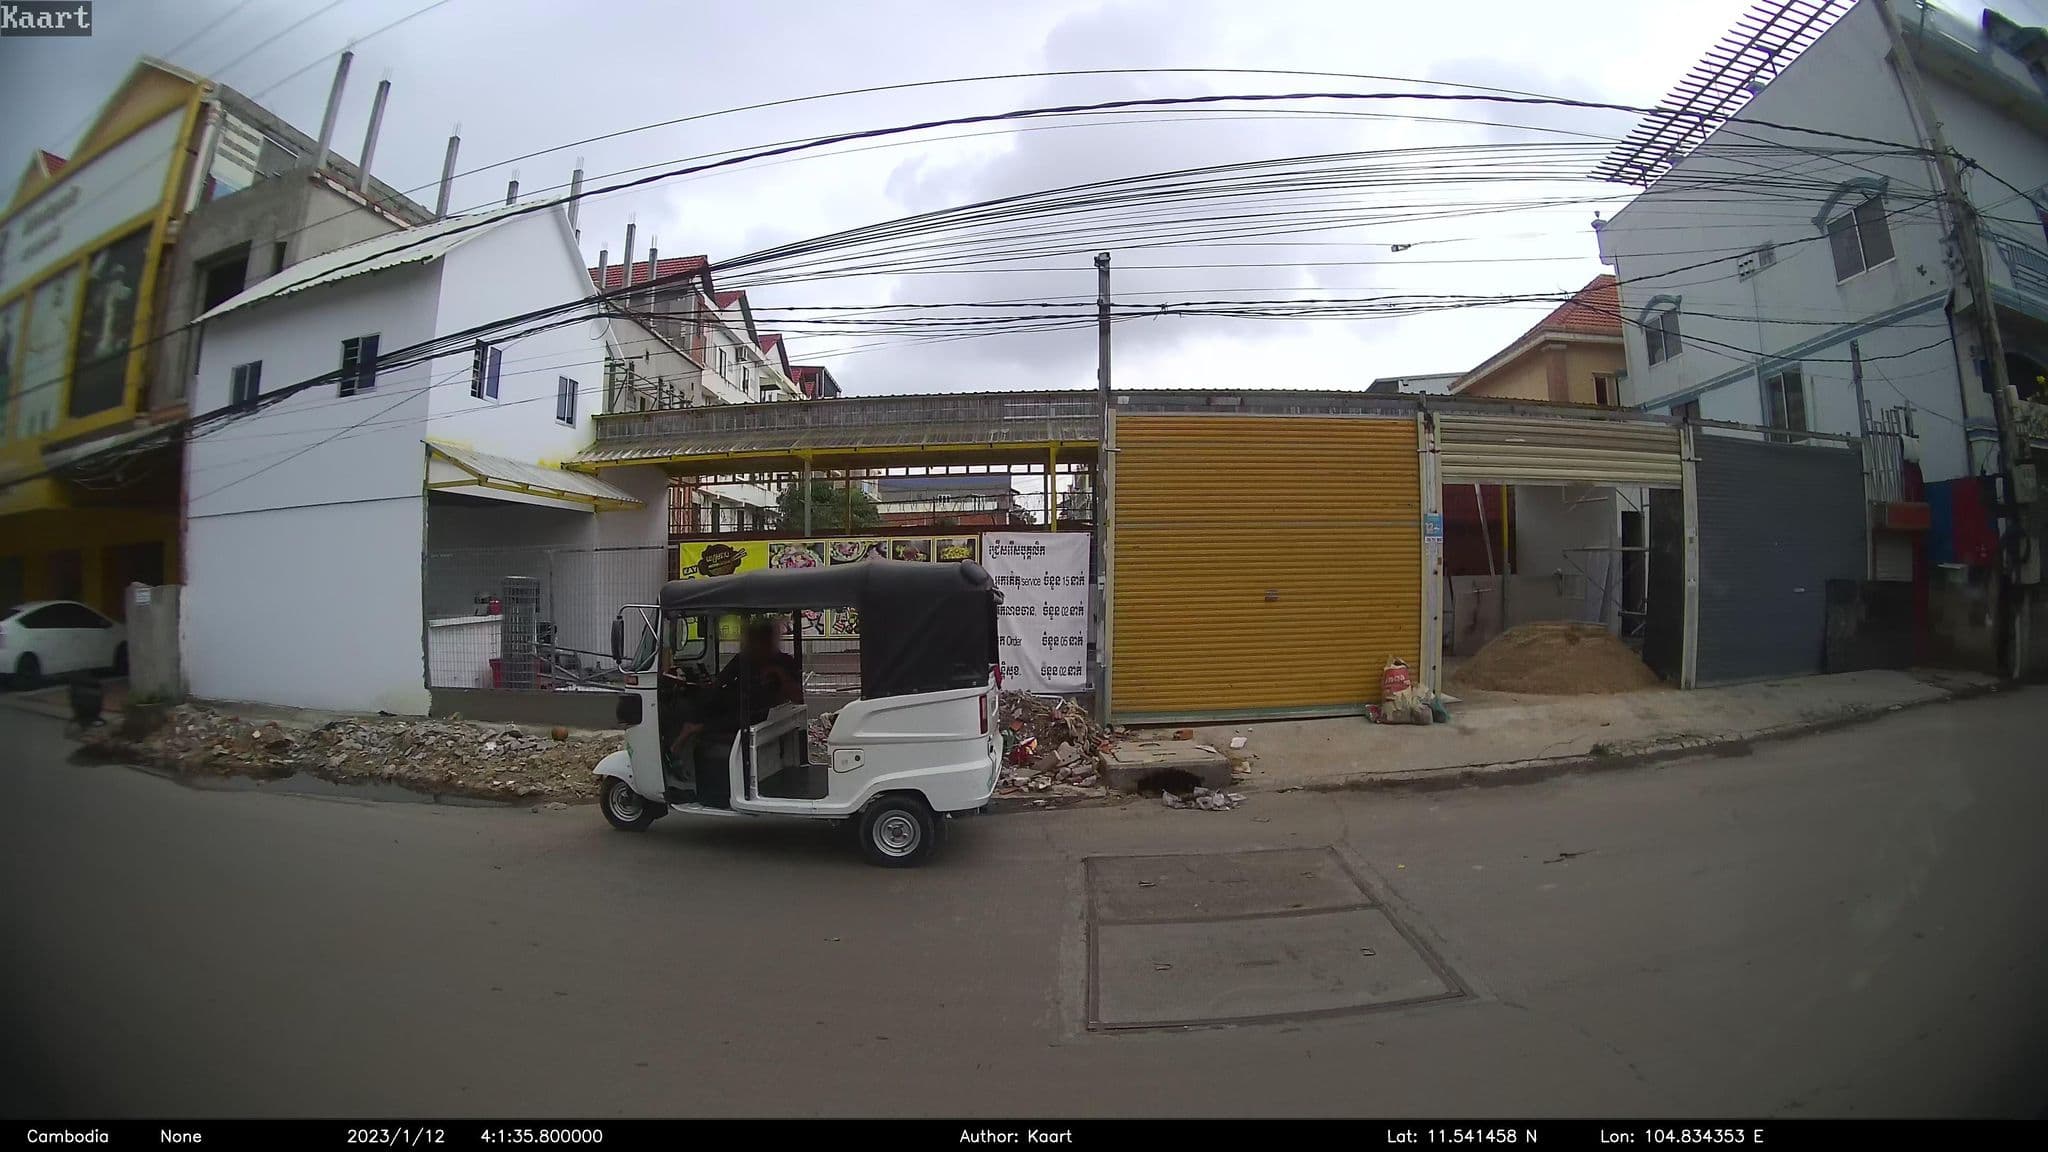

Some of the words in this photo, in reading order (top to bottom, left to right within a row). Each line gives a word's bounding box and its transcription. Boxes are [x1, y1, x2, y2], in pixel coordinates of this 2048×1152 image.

[1021, 577, 1041, 586] service
[1062, 575, 1070, 586] 15
[1070, 571, 1085, 586] នាក់
[1070, 601, 1084, 616] នាក់
[1006, 635, 1022, 646] Order
[1069, 630, 1083, 646] នាក់
[1068, 660, 1082, 676] នាក់
